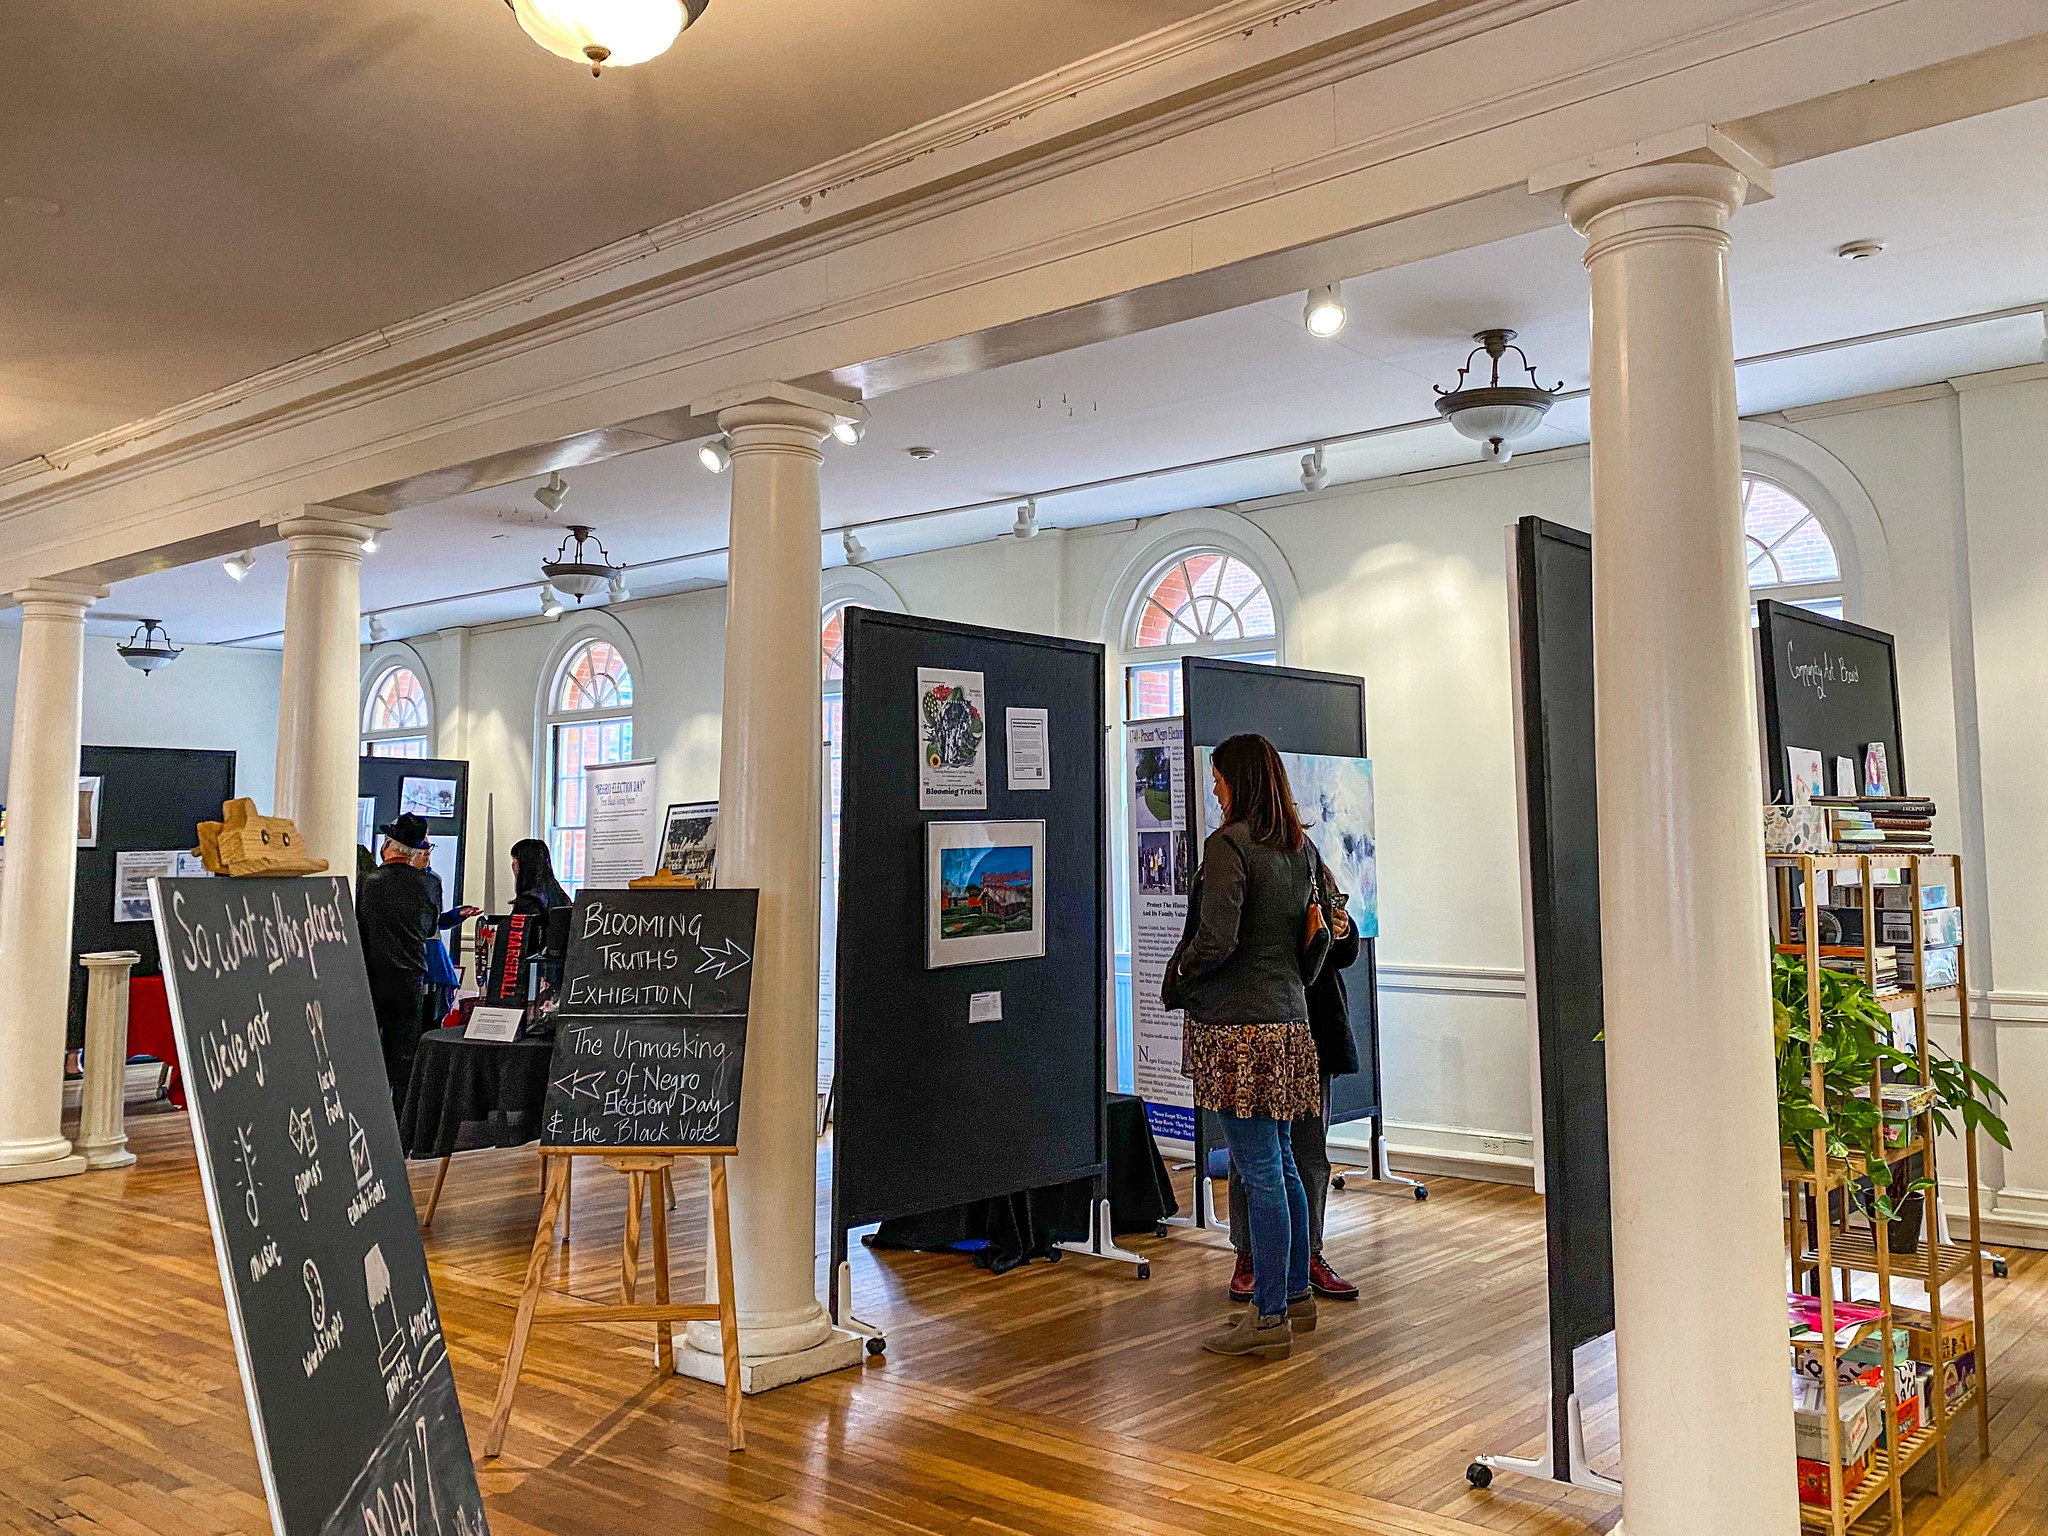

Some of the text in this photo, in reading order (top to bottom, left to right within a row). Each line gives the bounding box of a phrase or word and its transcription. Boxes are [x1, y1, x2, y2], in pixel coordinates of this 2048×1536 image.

[612, 780, 633, 794] ELECTION
[925, 787, 983, 797] Blooming Truths
[216, 896, 258, 971] what
[260, 916, 279, 959] is
[272, 892, 304, 965] this
[304, 877, 348, 979] place?
[580, 901, 703, 946] BLOOMING
[1158, 910, 1174, 918] Family
[500, 930, 524, 1000] MARSHALL
[597, 942, 678, 972] TRUTHS
[567, 974, 694, 1010] EXHIBITION
[201, 993, 272, 1093] We've got
[568, 1024, 734, 1077] The Unmasking
[615, 1063, 700, 1104] of Negro
[602, 1089, 734, 1128] Election Day
[571, 1118, 606, 1144] the
[613, 1118, 670, 1145] Black
[679, 1119, 721, 1143] Vote
[294, 1159, 323, 1222] games
[250, 1234, 283, 1282] music
